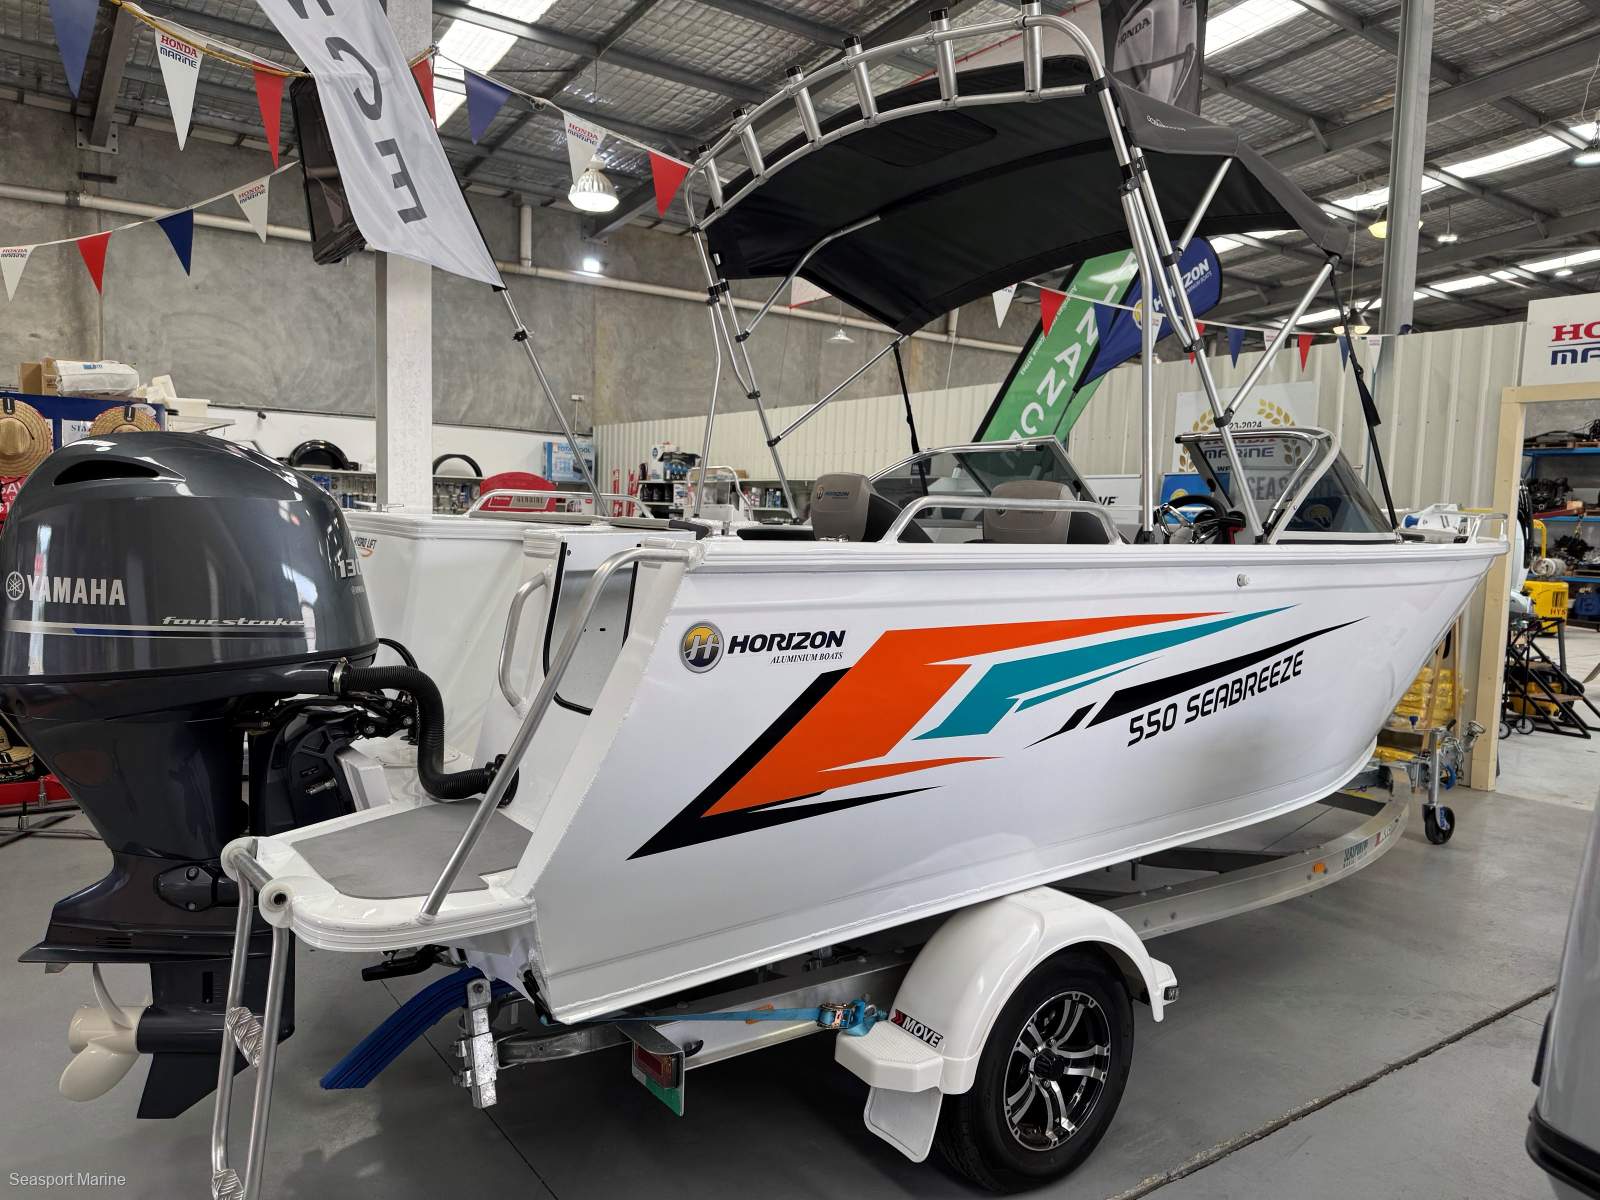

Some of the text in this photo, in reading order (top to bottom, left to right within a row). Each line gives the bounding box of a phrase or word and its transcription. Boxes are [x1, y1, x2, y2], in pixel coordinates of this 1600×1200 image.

[160, 34, 198, 58] HONDA
[160, 46, 198, 69] MARINE
[568, 122, 599, 140] HONDA
[27, 574, 126, 606] YAMAHA
[728, 630, 847, 654] HORIZON
[770, 652, 844, 665] ALUMINIUM BOATS
[1127, 650, 1305, 747] 550 SEABREEZE
[902, 1016, 941, 1049] MOVE
